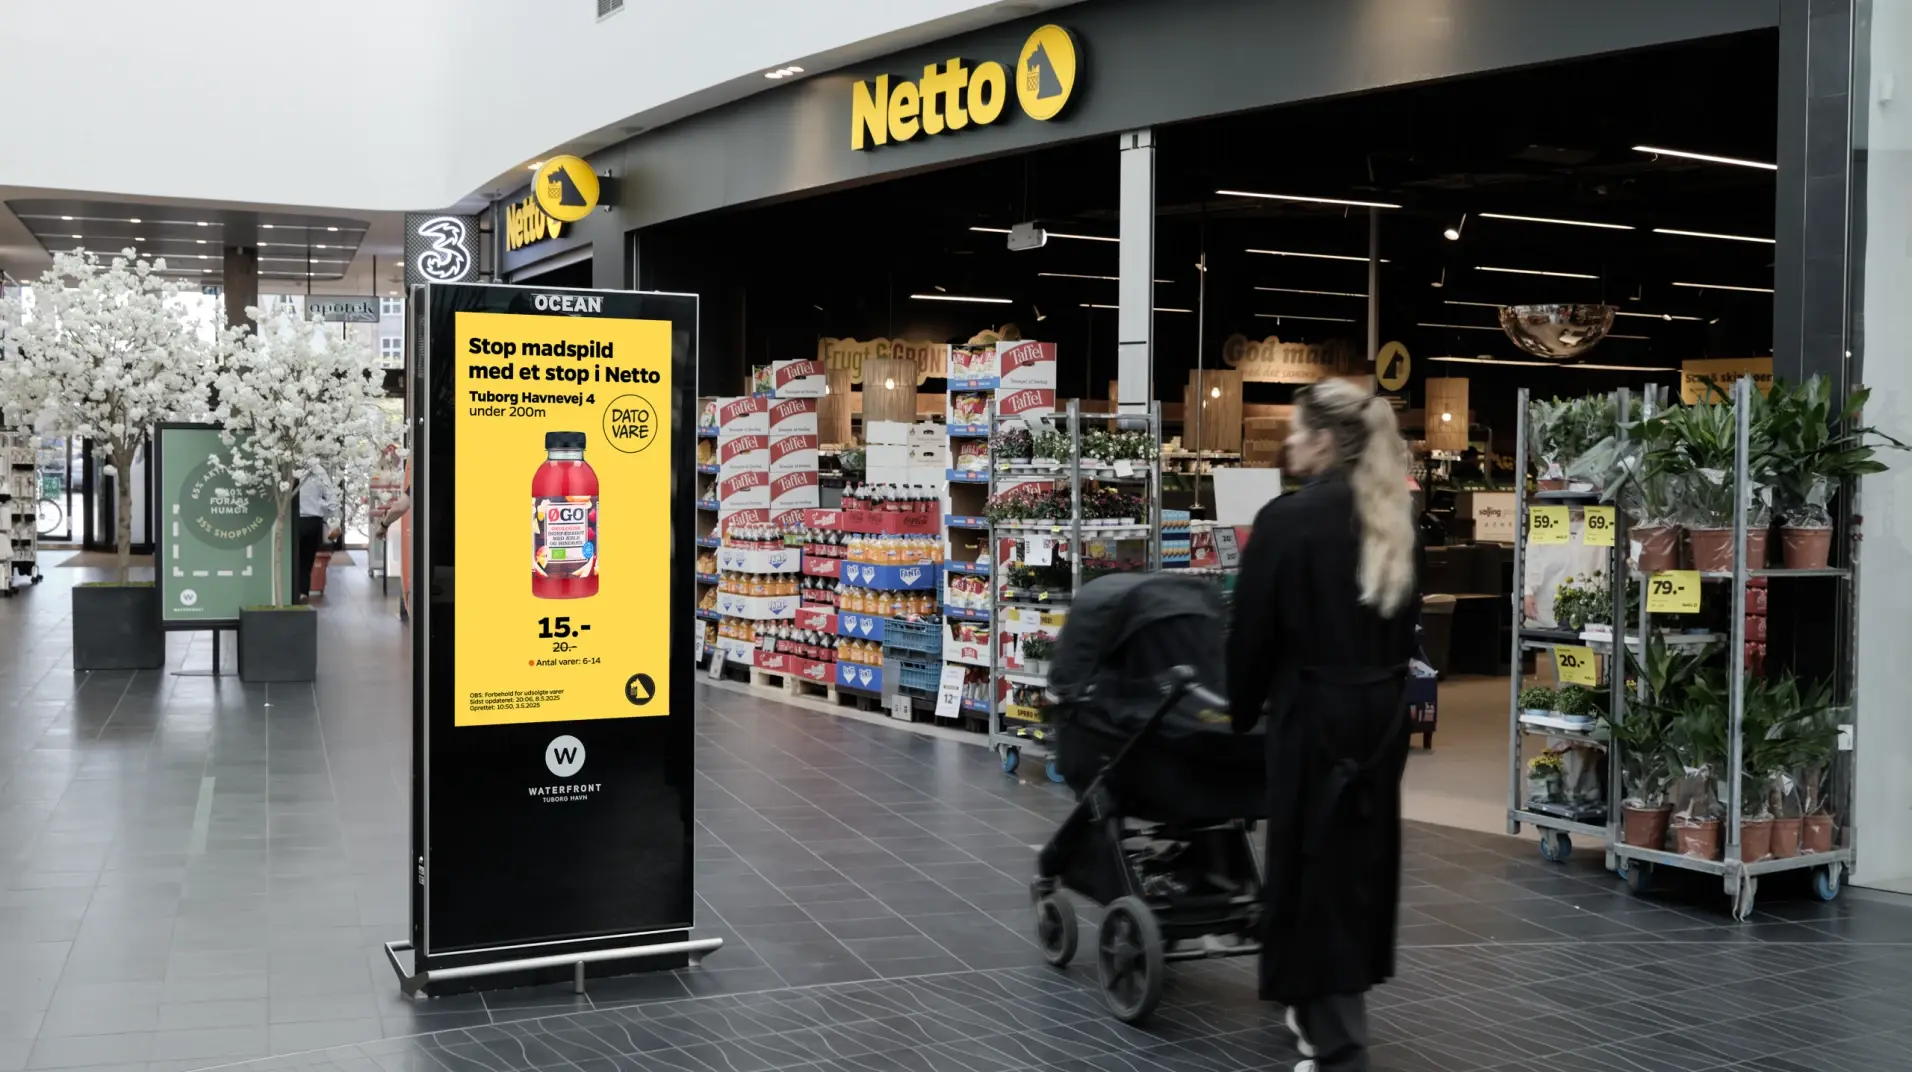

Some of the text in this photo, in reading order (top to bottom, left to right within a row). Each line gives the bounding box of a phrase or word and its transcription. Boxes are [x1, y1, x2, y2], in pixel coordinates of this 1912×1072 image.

[852, 57, 1006, 150] Netto
[309, 301, 373, 316] apotek
[534, 294, 602, 313] OCEAN
[469, 337, 614, 361] Stop madspild
[1009, 344, 1044, 365] Taffel
[468, 363, 661, 384] med et stop i Netto
[783, 361, 816, 379] Taffel
[469, 391, 595, 407] Tuborg Havnevej 4
[1008, 390, 1042, 412] Taffel
[469, 406, 546, 417] under 200m
[612, 409, 649, 423] DATO
[727, 399, 758, 417] Taffel
[776, 399, 806, 418] Taffel
[611, 424, 649, 439] VARE
[728, 435, 759, 454] Taffel
[777, 435, 808, 454] Taffel
[728, 473, 760, 491] Taffel
[778, 472, 809, 492] Taffel
[548, 508, 584, 522] ØGO
[1478, 506, 1502, 518] salling
[196, 516, 264, 540] 35% SHOPPING
[900, 567, 921, 578] FANTA
[1653, 580, 1685, 595] 79.-
[537, 616, 591, 639] 15.-
[552, 642, 578, 653] 20.-
[535, 657, 601, 667] Antal varer: 6-14
[1559, 654, 1585, 668] 20.-
[485, 690, 514, 698] Forbehold
[523, 689, 549, 697] udsolgte
[485, 697, 515, 705] opdateret:
[469, 704, 495, 712] Oprettet:
[553, 747, 577, 764] W
[528, 783, 602, 796] WATERFRONT
[542, 795, 569, 803] TUBORG
